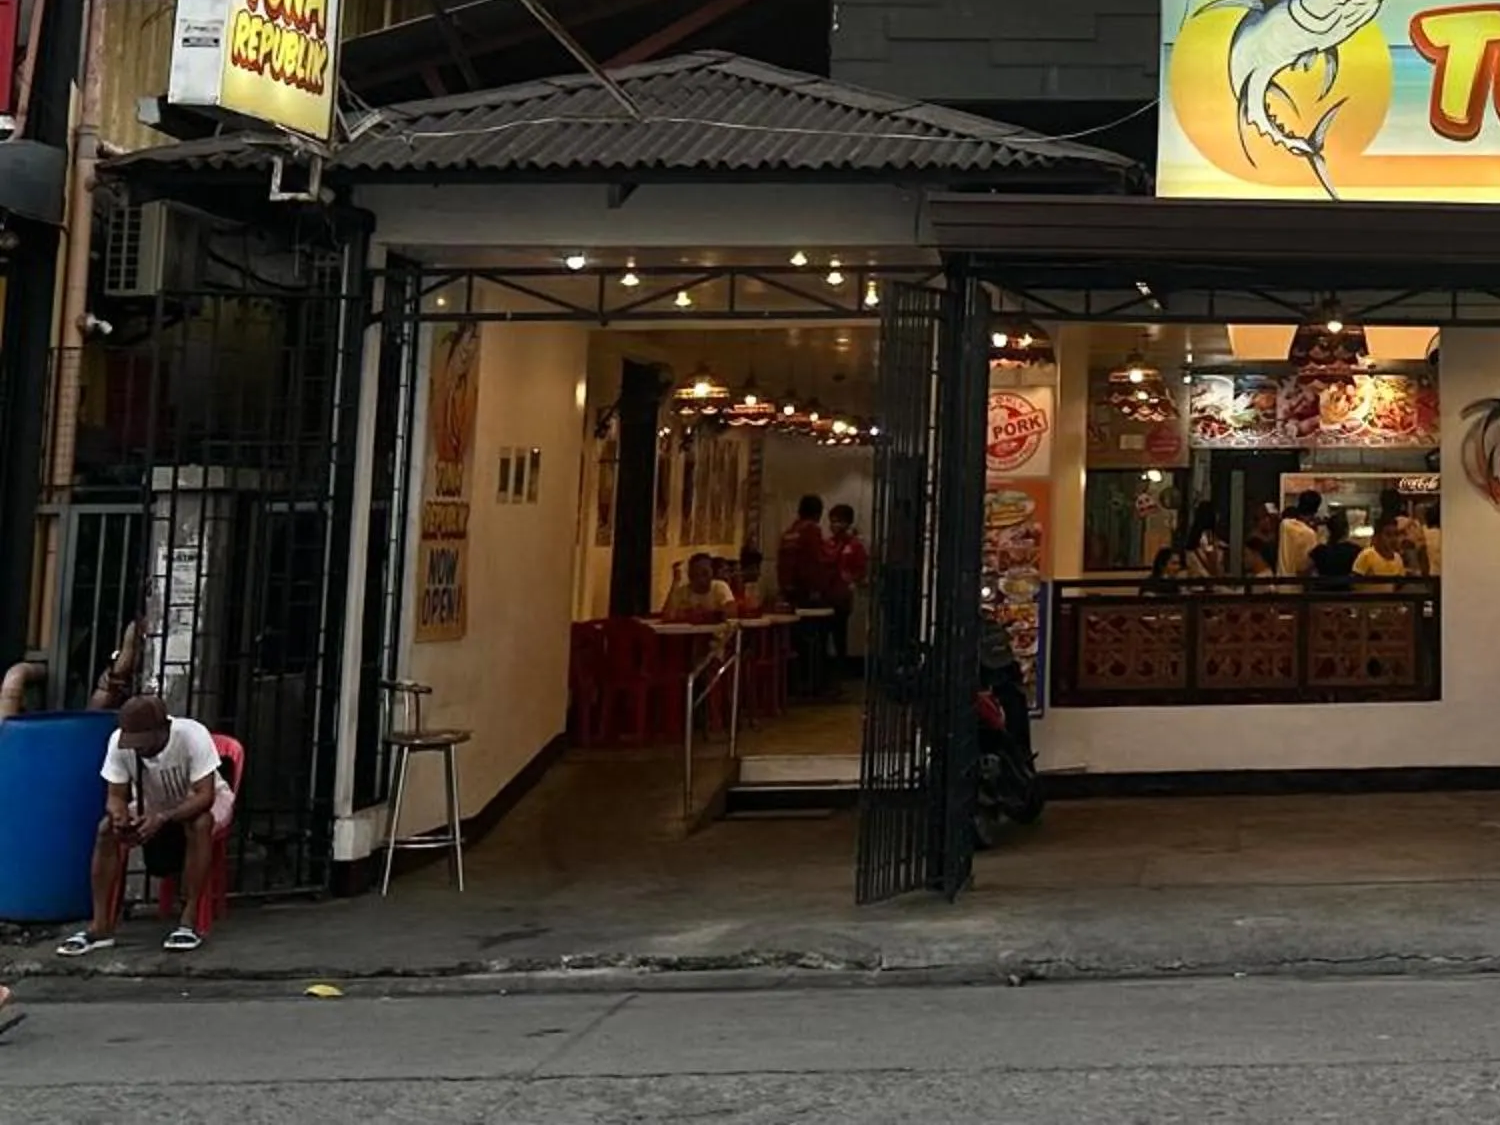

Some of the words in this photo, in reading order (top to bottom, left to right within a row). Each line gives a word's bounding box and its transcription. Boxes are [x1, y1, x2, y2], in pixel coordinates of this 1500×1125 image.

[231, 8, 329, 96] REPUBLIK
[993, 415, 1041, 440] PORK
[428, 547, 459, 586] NOW
[422, 583, 463, 626] OPEN!
